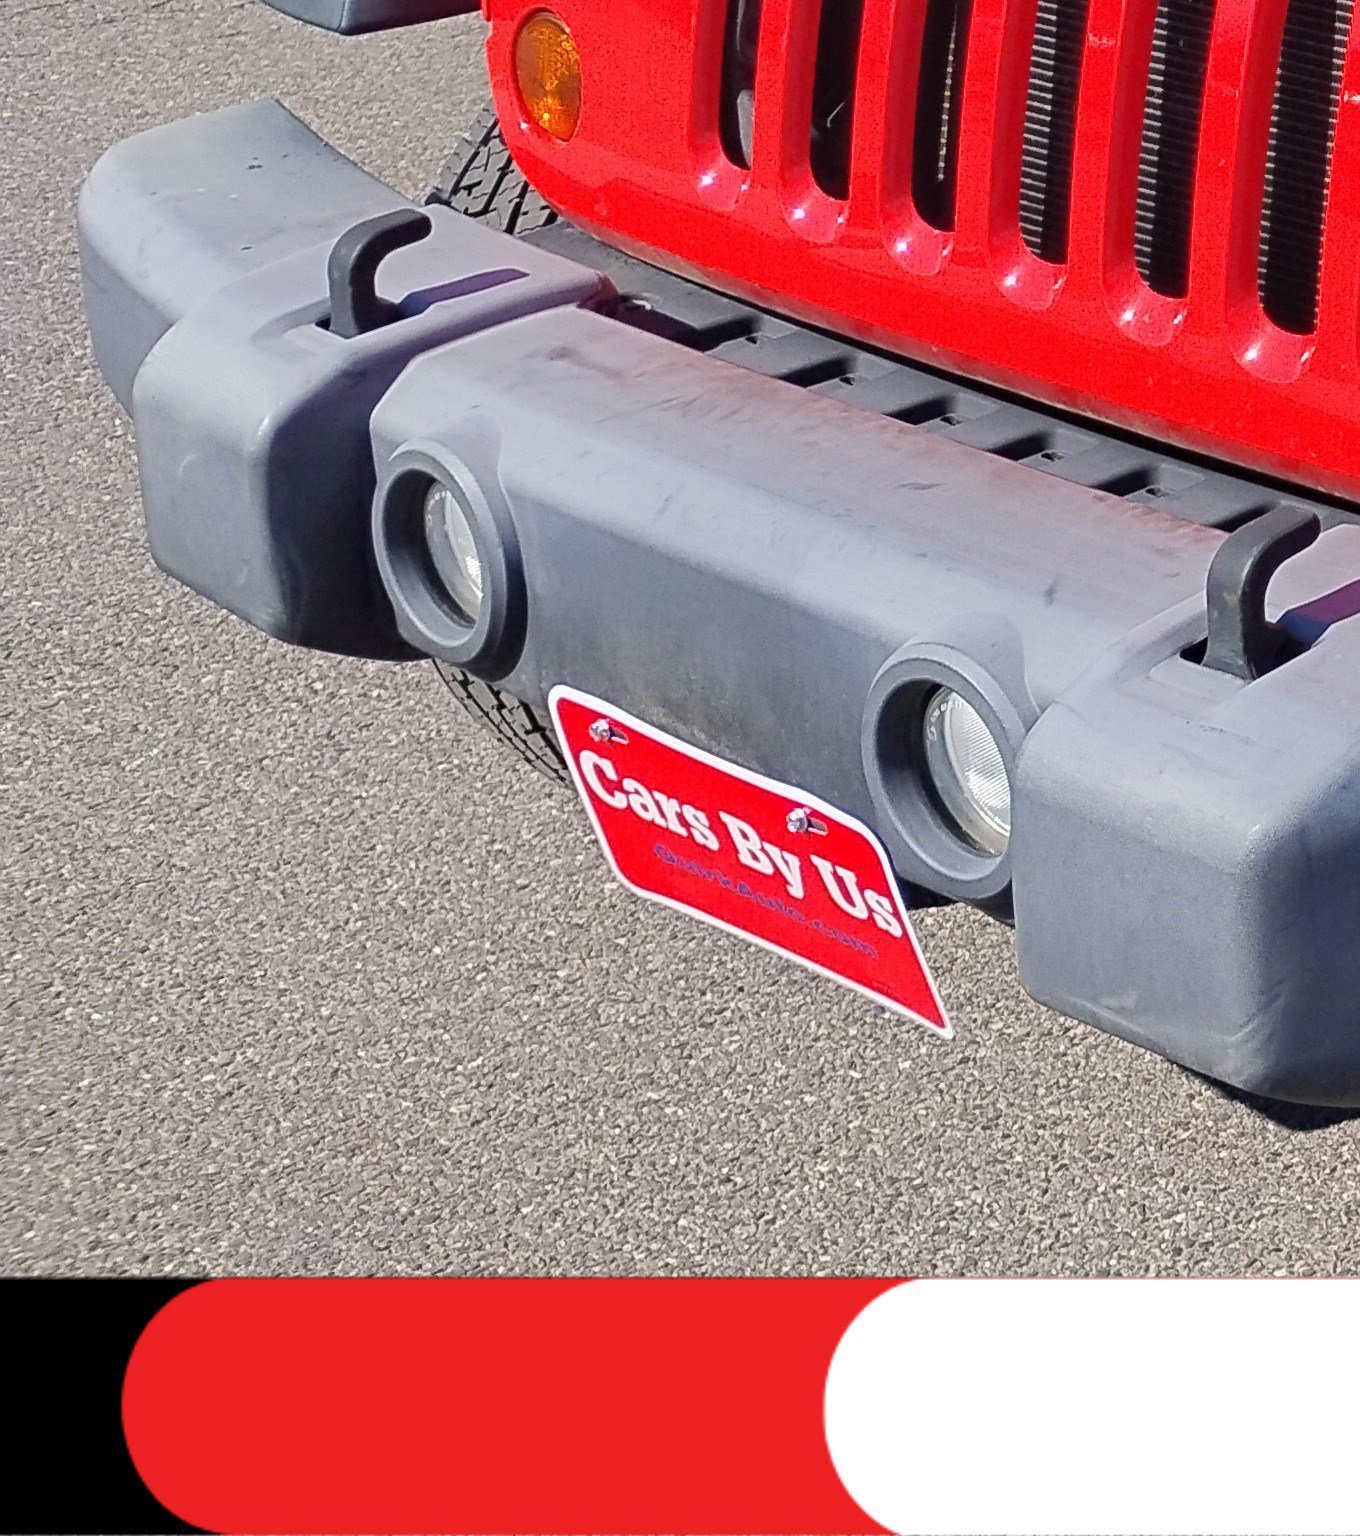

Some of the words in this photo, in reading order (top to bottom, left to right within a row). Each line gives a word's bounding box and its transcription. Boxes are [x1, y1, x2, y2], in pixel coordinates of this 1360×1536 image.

[578, 750, 720, 851] Cars
[719, 811, 805, 900] By
[810, 855, 903, 939] Us
